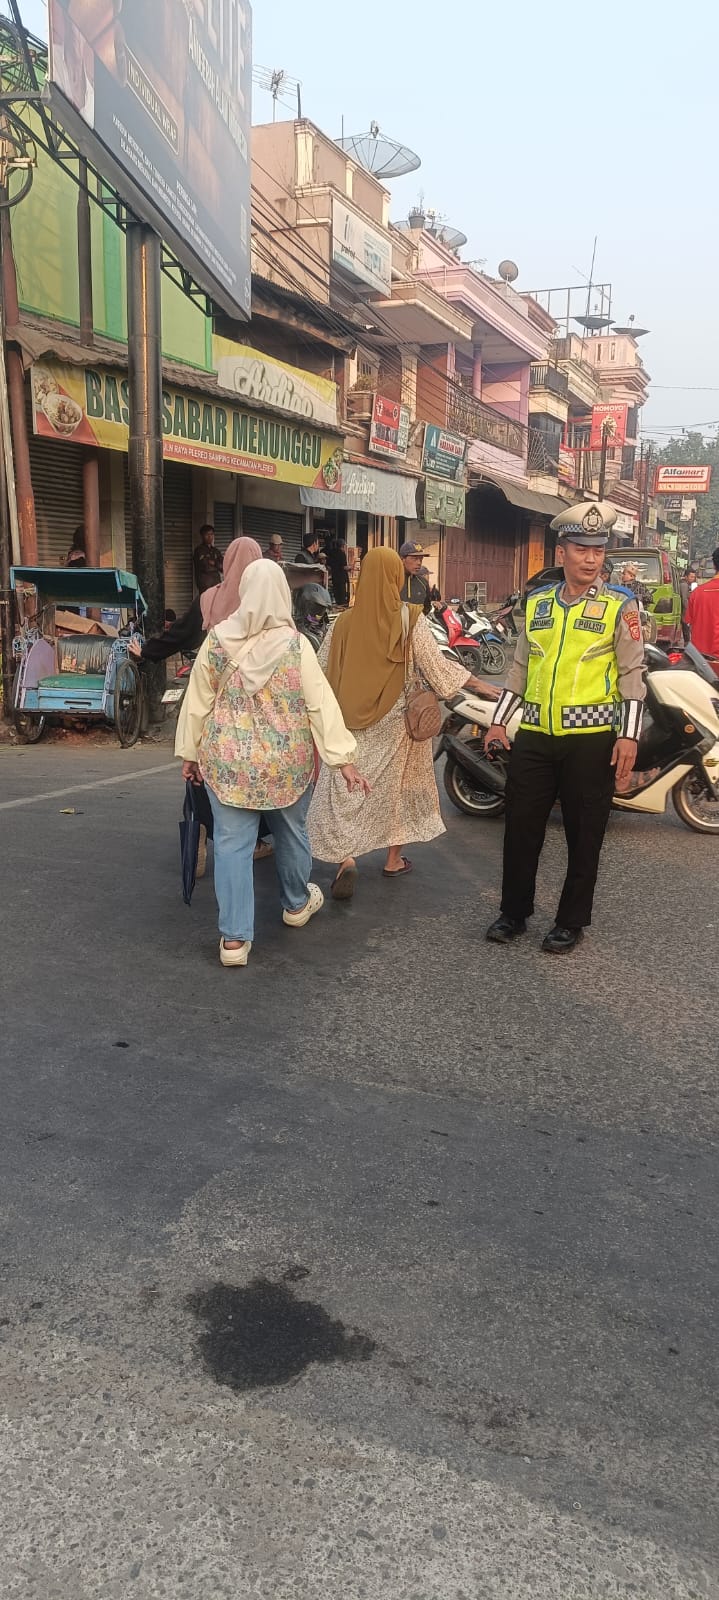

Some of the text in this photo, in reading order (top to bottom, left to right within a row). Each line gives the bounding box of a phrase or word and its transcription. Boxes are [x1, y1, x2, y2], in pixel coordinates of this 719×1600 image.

[84, 367, 322, 470] BAS SABAR MENUNGGU
[173, 445, 188, 456] RAYA
[188, 448, 208, 459] PLERED
[663, 468, 705, 476] Alfamart
[577, 621, 603, 632] POLISI
